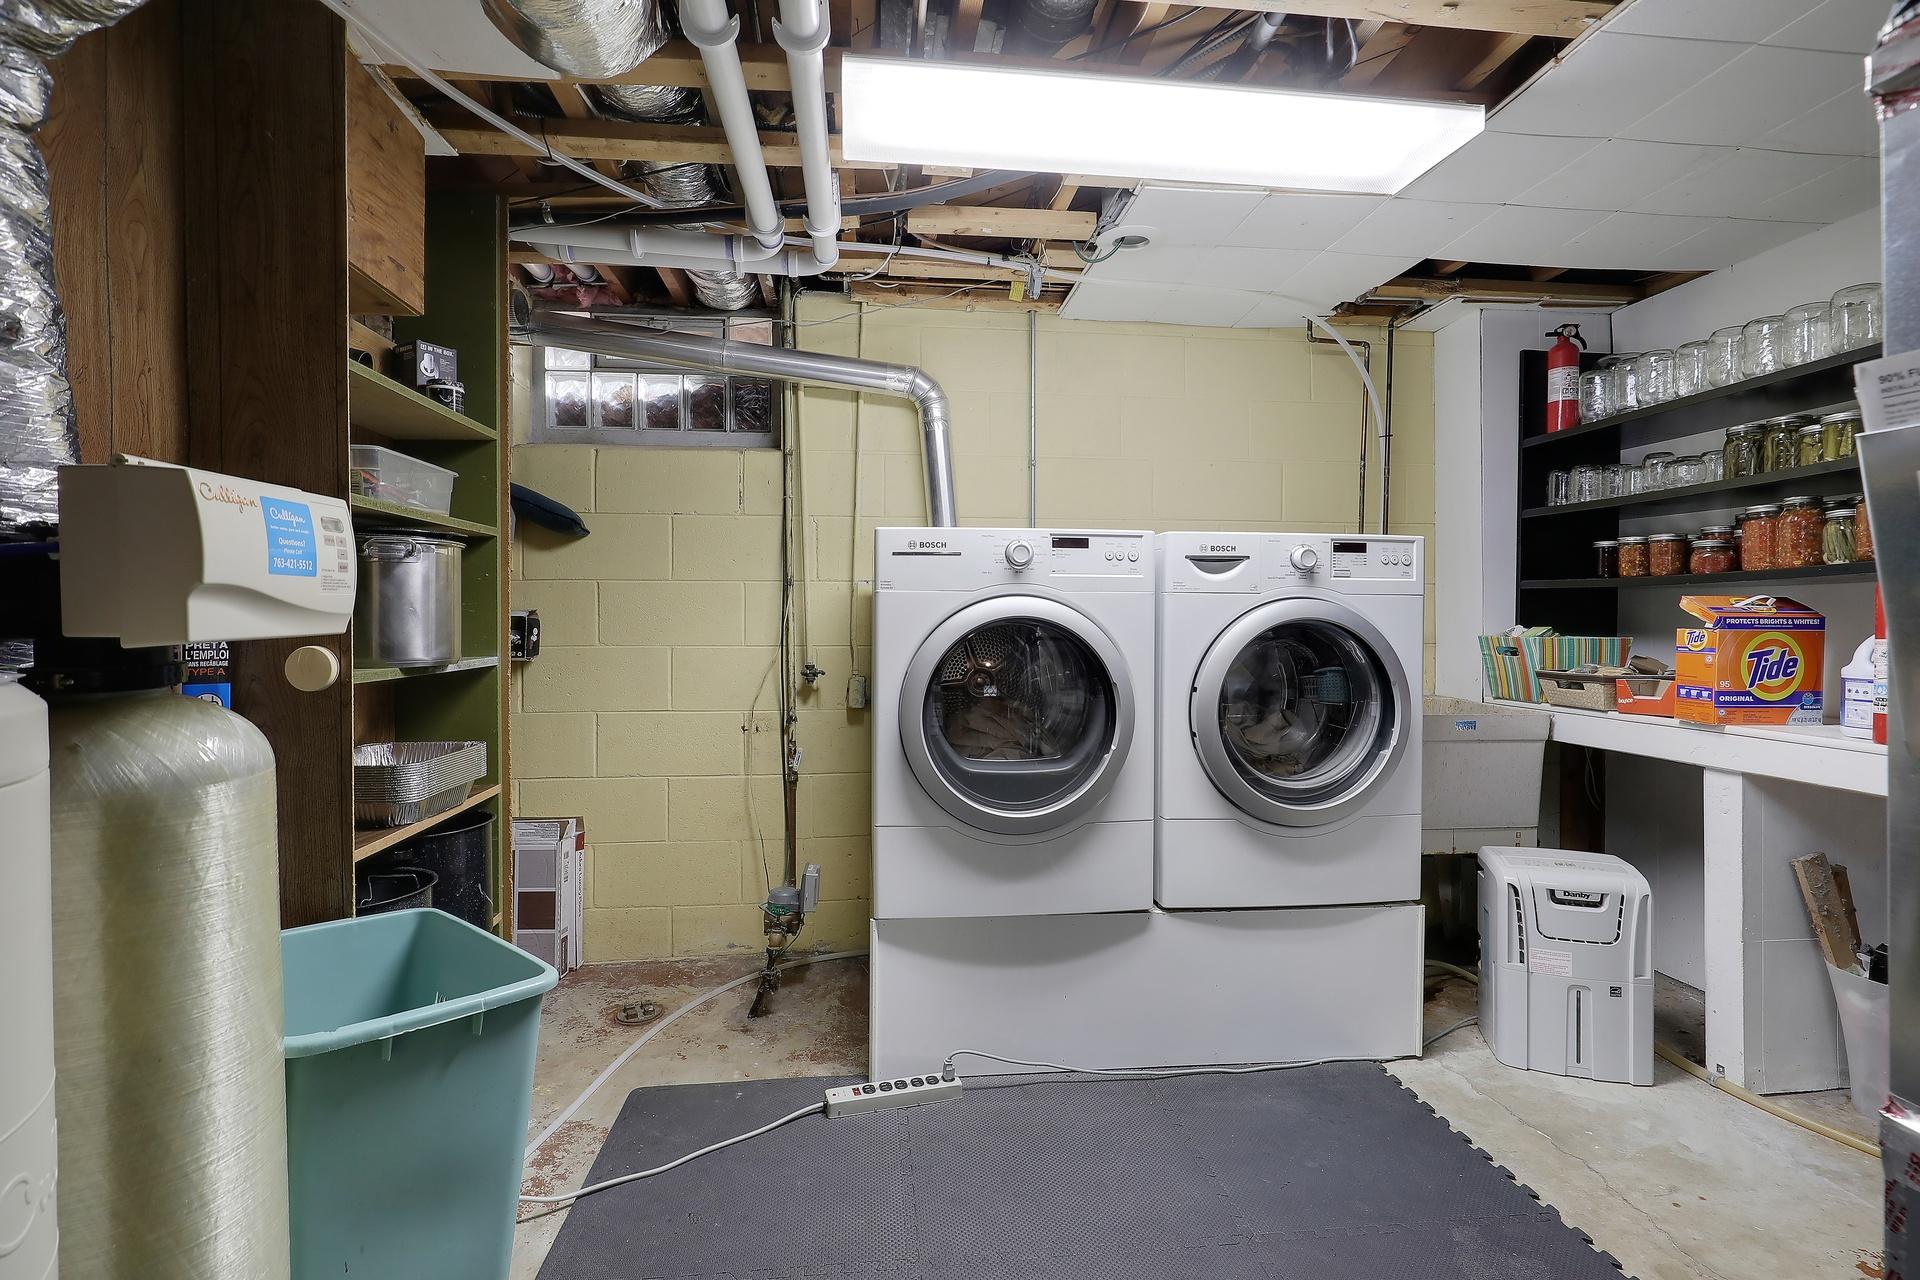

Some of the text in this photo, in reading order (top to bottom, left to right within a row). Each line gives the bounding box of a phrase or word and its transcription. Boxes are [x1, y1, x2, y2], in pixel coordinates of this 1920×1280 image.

[199, 481, 259, 513] Culligan
[269, 506, 306, 527] Culligan
[278, 537, 306, 548] Questions?
[919, 541, 947, 549] BOSCH
[273, 557, 313, 571] 763-421-5512
[1686, 631, 1706, 645] Tide
[185, 650, 229, 660] L'EMPLOI
[186, 667, 226, 676] TYPE A
[1746, 647, 1800, 690] Tide
[1719, 680, 1731, 688] 95
[1563, 890, 1590, 900] Danby
